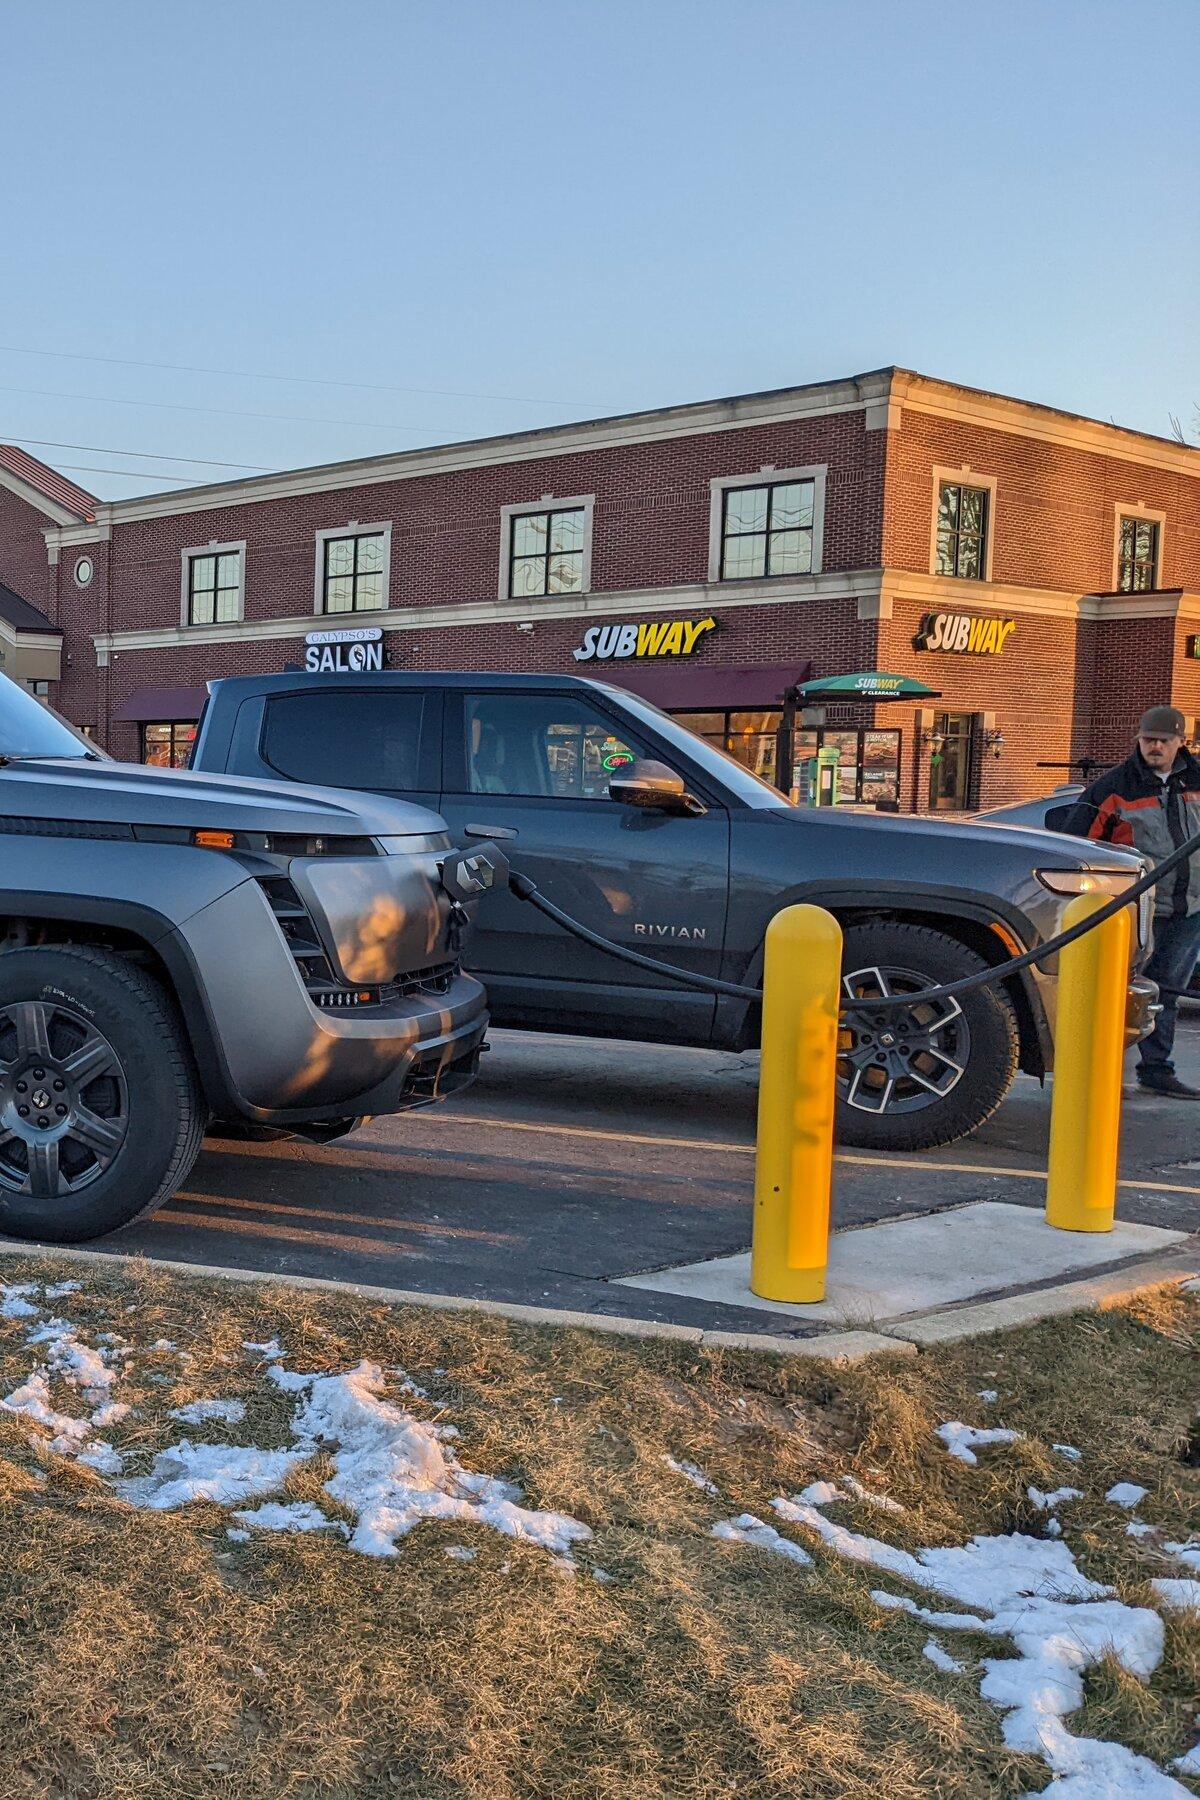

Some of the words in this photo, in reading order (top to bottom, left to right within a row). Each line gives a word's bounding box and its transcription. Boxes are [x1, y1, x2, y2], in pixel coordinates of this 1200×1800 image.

[311, 629, 376, 643] CALYPSO'S
[573, 616, 716, 661] SUBWAY
[926, 613, 1016, 654] SUBWAY
[305, 643, 383, 672] SALON
[854, 678, 904, 689] SUBWAY
[634, 923, 706, 939] RIVIAN
